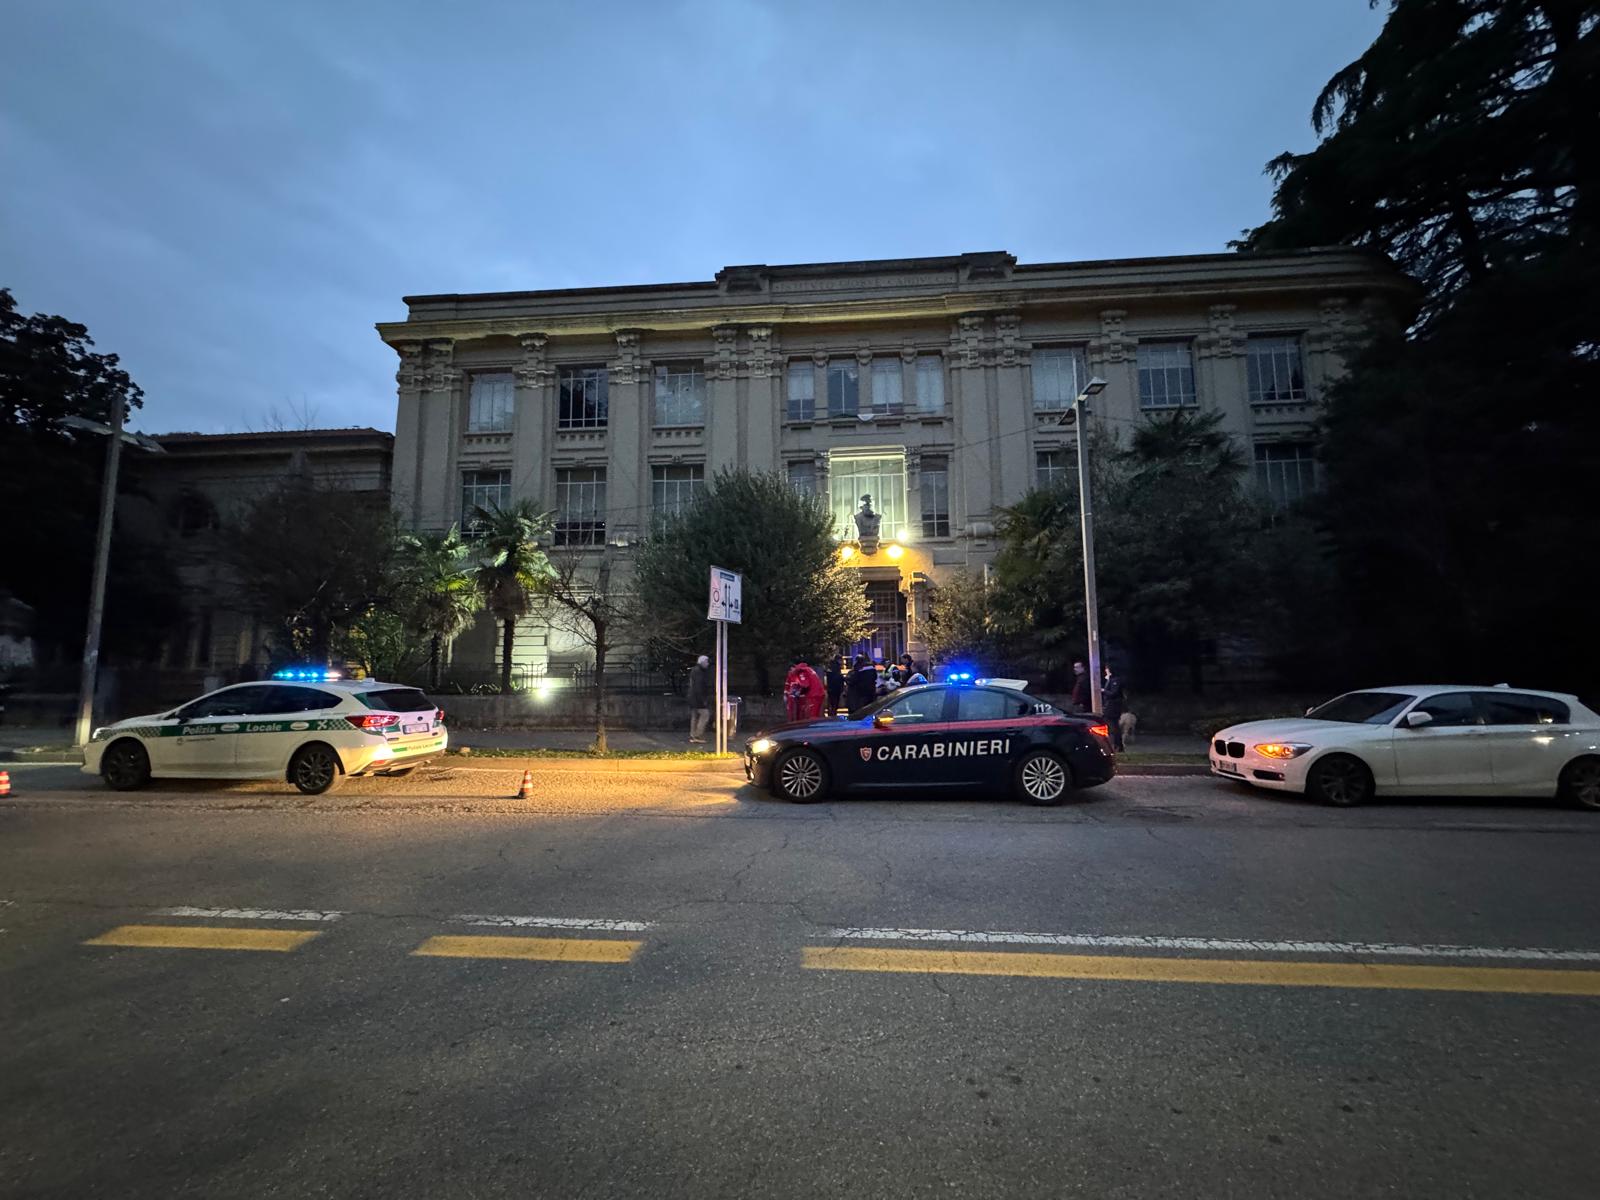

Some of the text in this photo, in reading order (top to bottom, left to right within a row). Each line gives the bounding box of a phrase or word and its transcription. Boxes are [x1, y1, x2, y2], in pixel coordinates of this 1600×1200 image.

[1033, 703, 1052, 713] 112
[182, 723, 282, 735] Polizia Locale
[877, 738, 1010, 761] CARABINIERI
